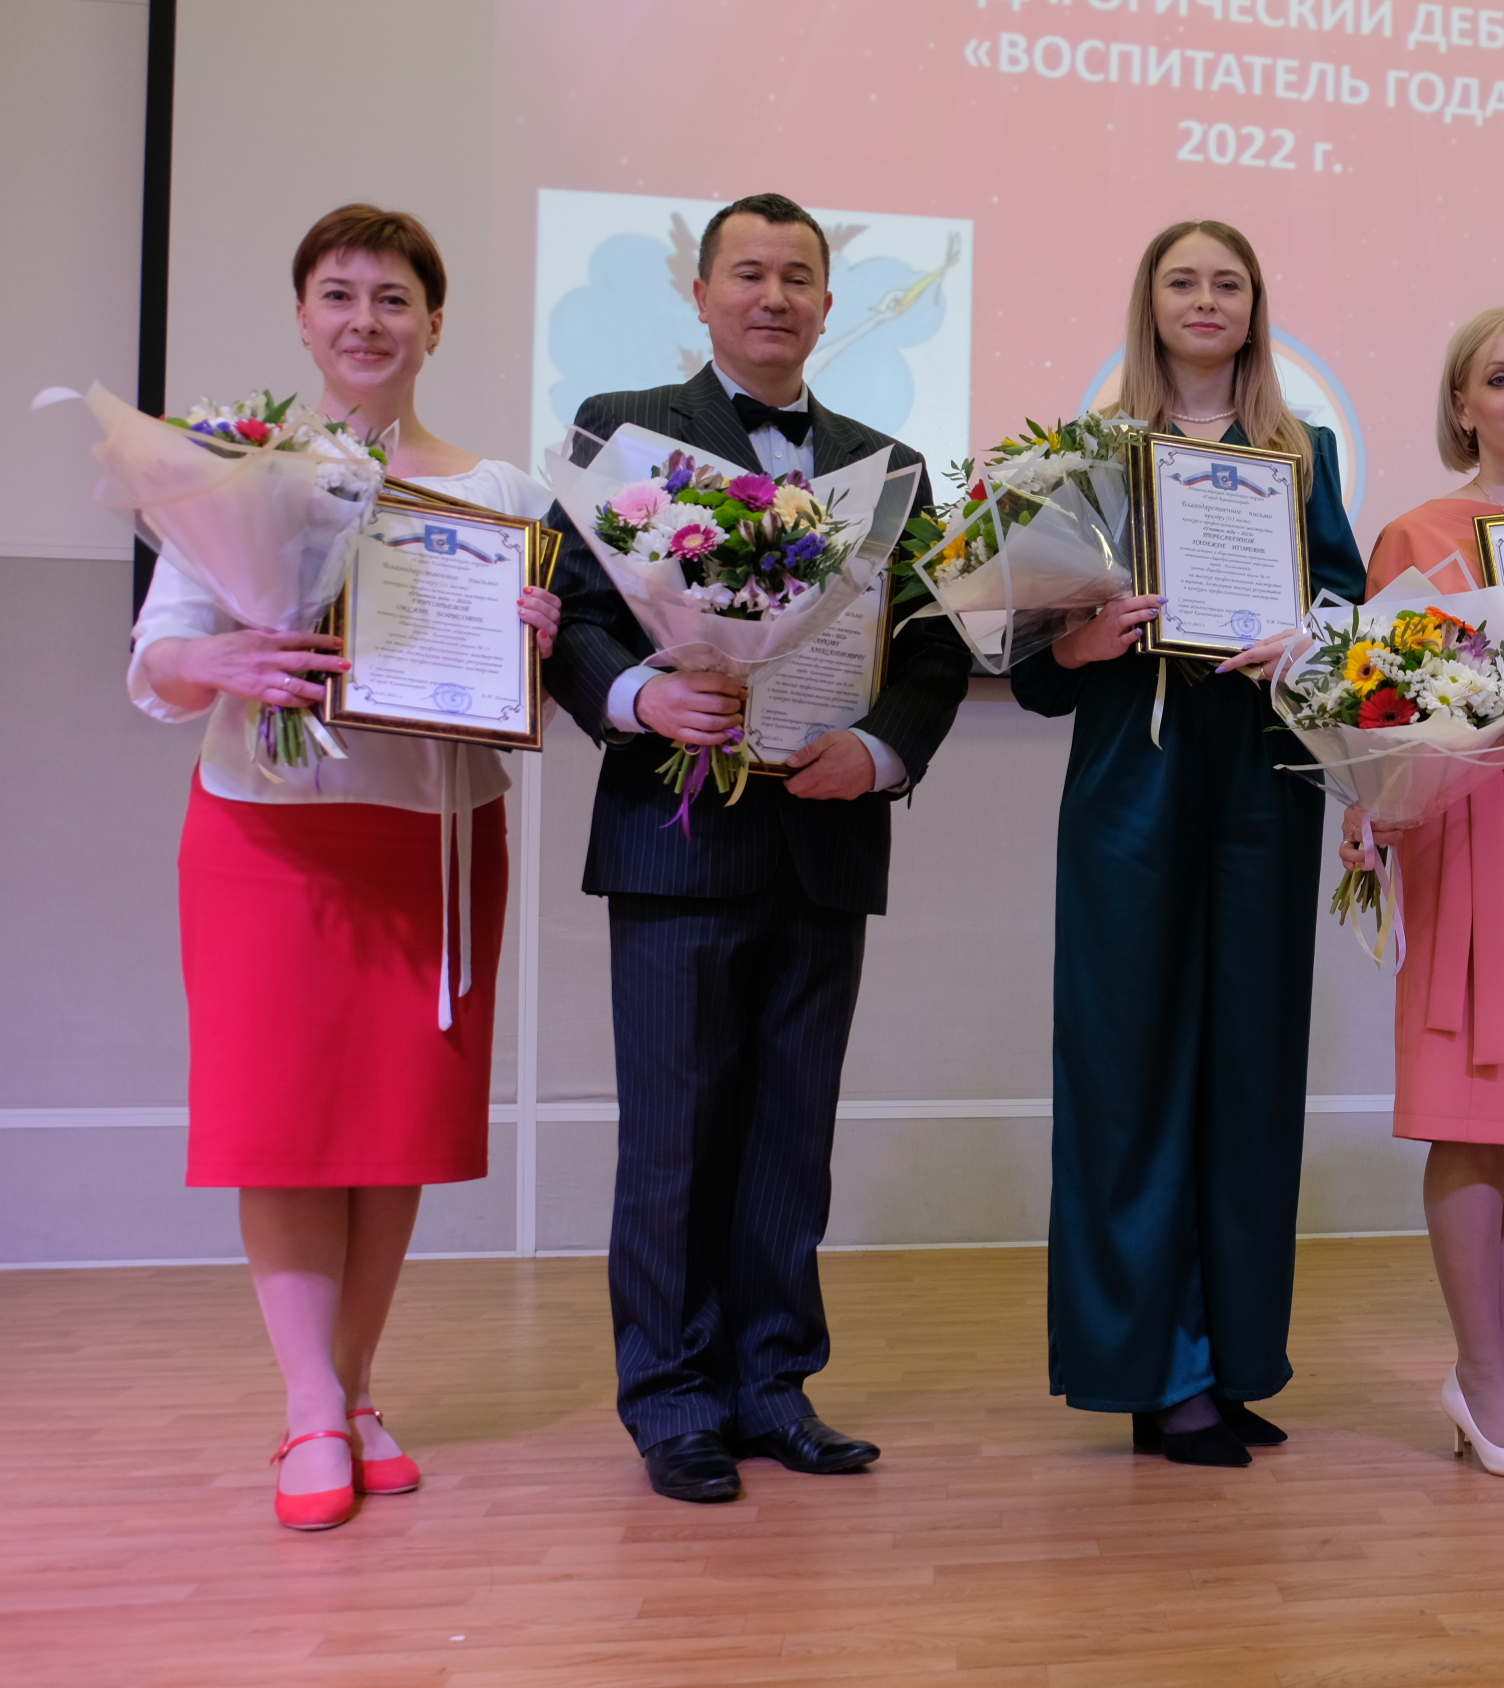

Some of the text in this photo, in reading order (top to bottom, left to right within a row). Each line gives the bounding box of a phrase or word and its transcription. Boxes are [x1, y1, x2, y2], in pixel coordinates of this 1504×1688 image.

[963, 31, 1370, 105] «ВОСПИТАТЕЛЬ
[1177, 119, 1343, 174] 2022 г.
[1181, 501, 1241, 514] Благодарственное
[383, 563, 499, 586] Благодарственное письмо
